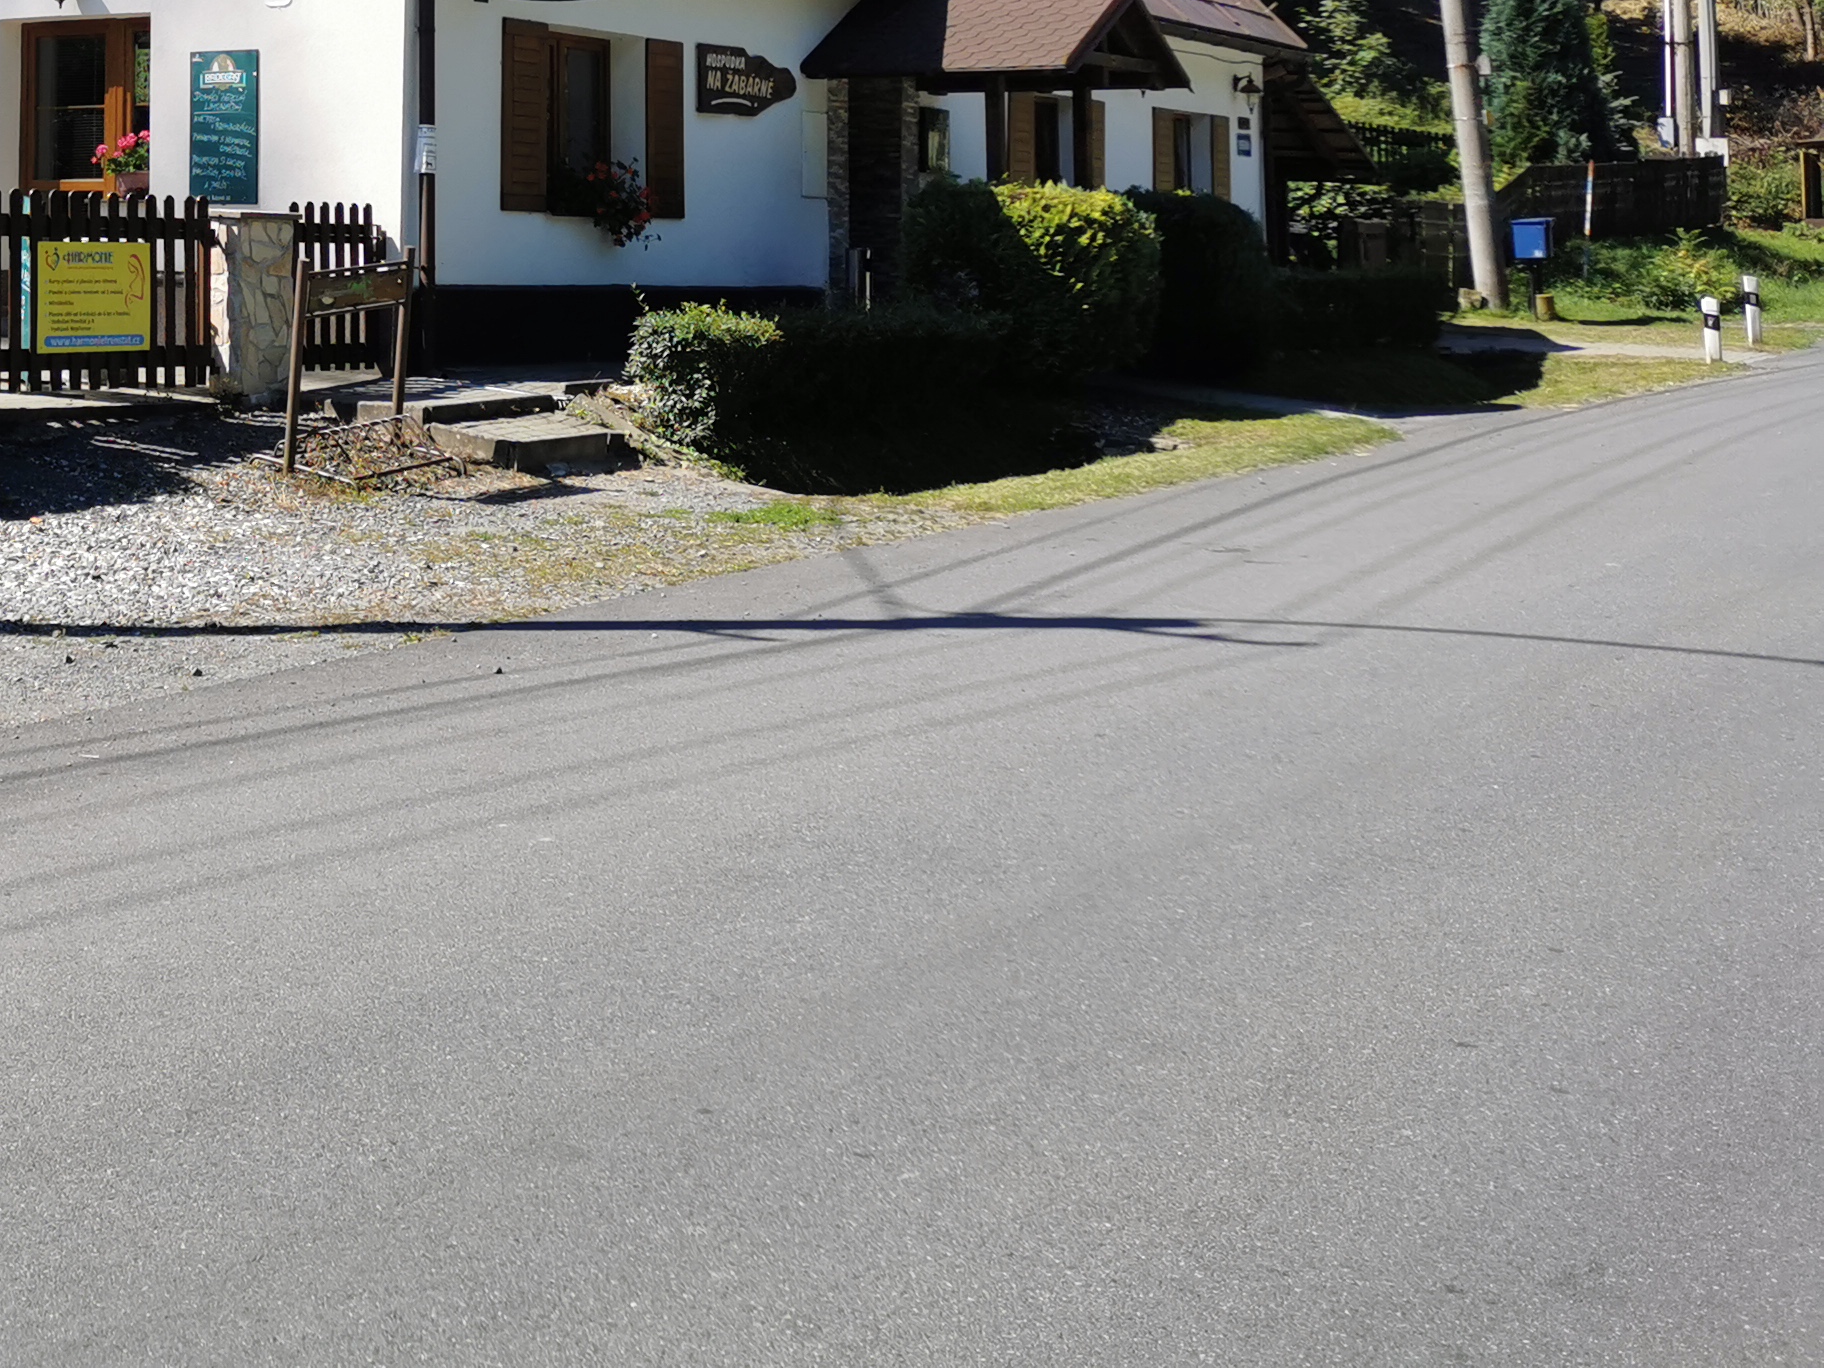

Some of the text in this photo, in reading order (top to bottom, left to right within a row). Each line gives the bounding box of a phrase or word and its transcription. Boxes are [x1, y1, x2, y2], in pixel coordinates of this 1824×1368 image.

[706, 51, 746, 71] HOSPŮDKA
[706, 70, 775, 99] NA ŽABÁRNĚ
